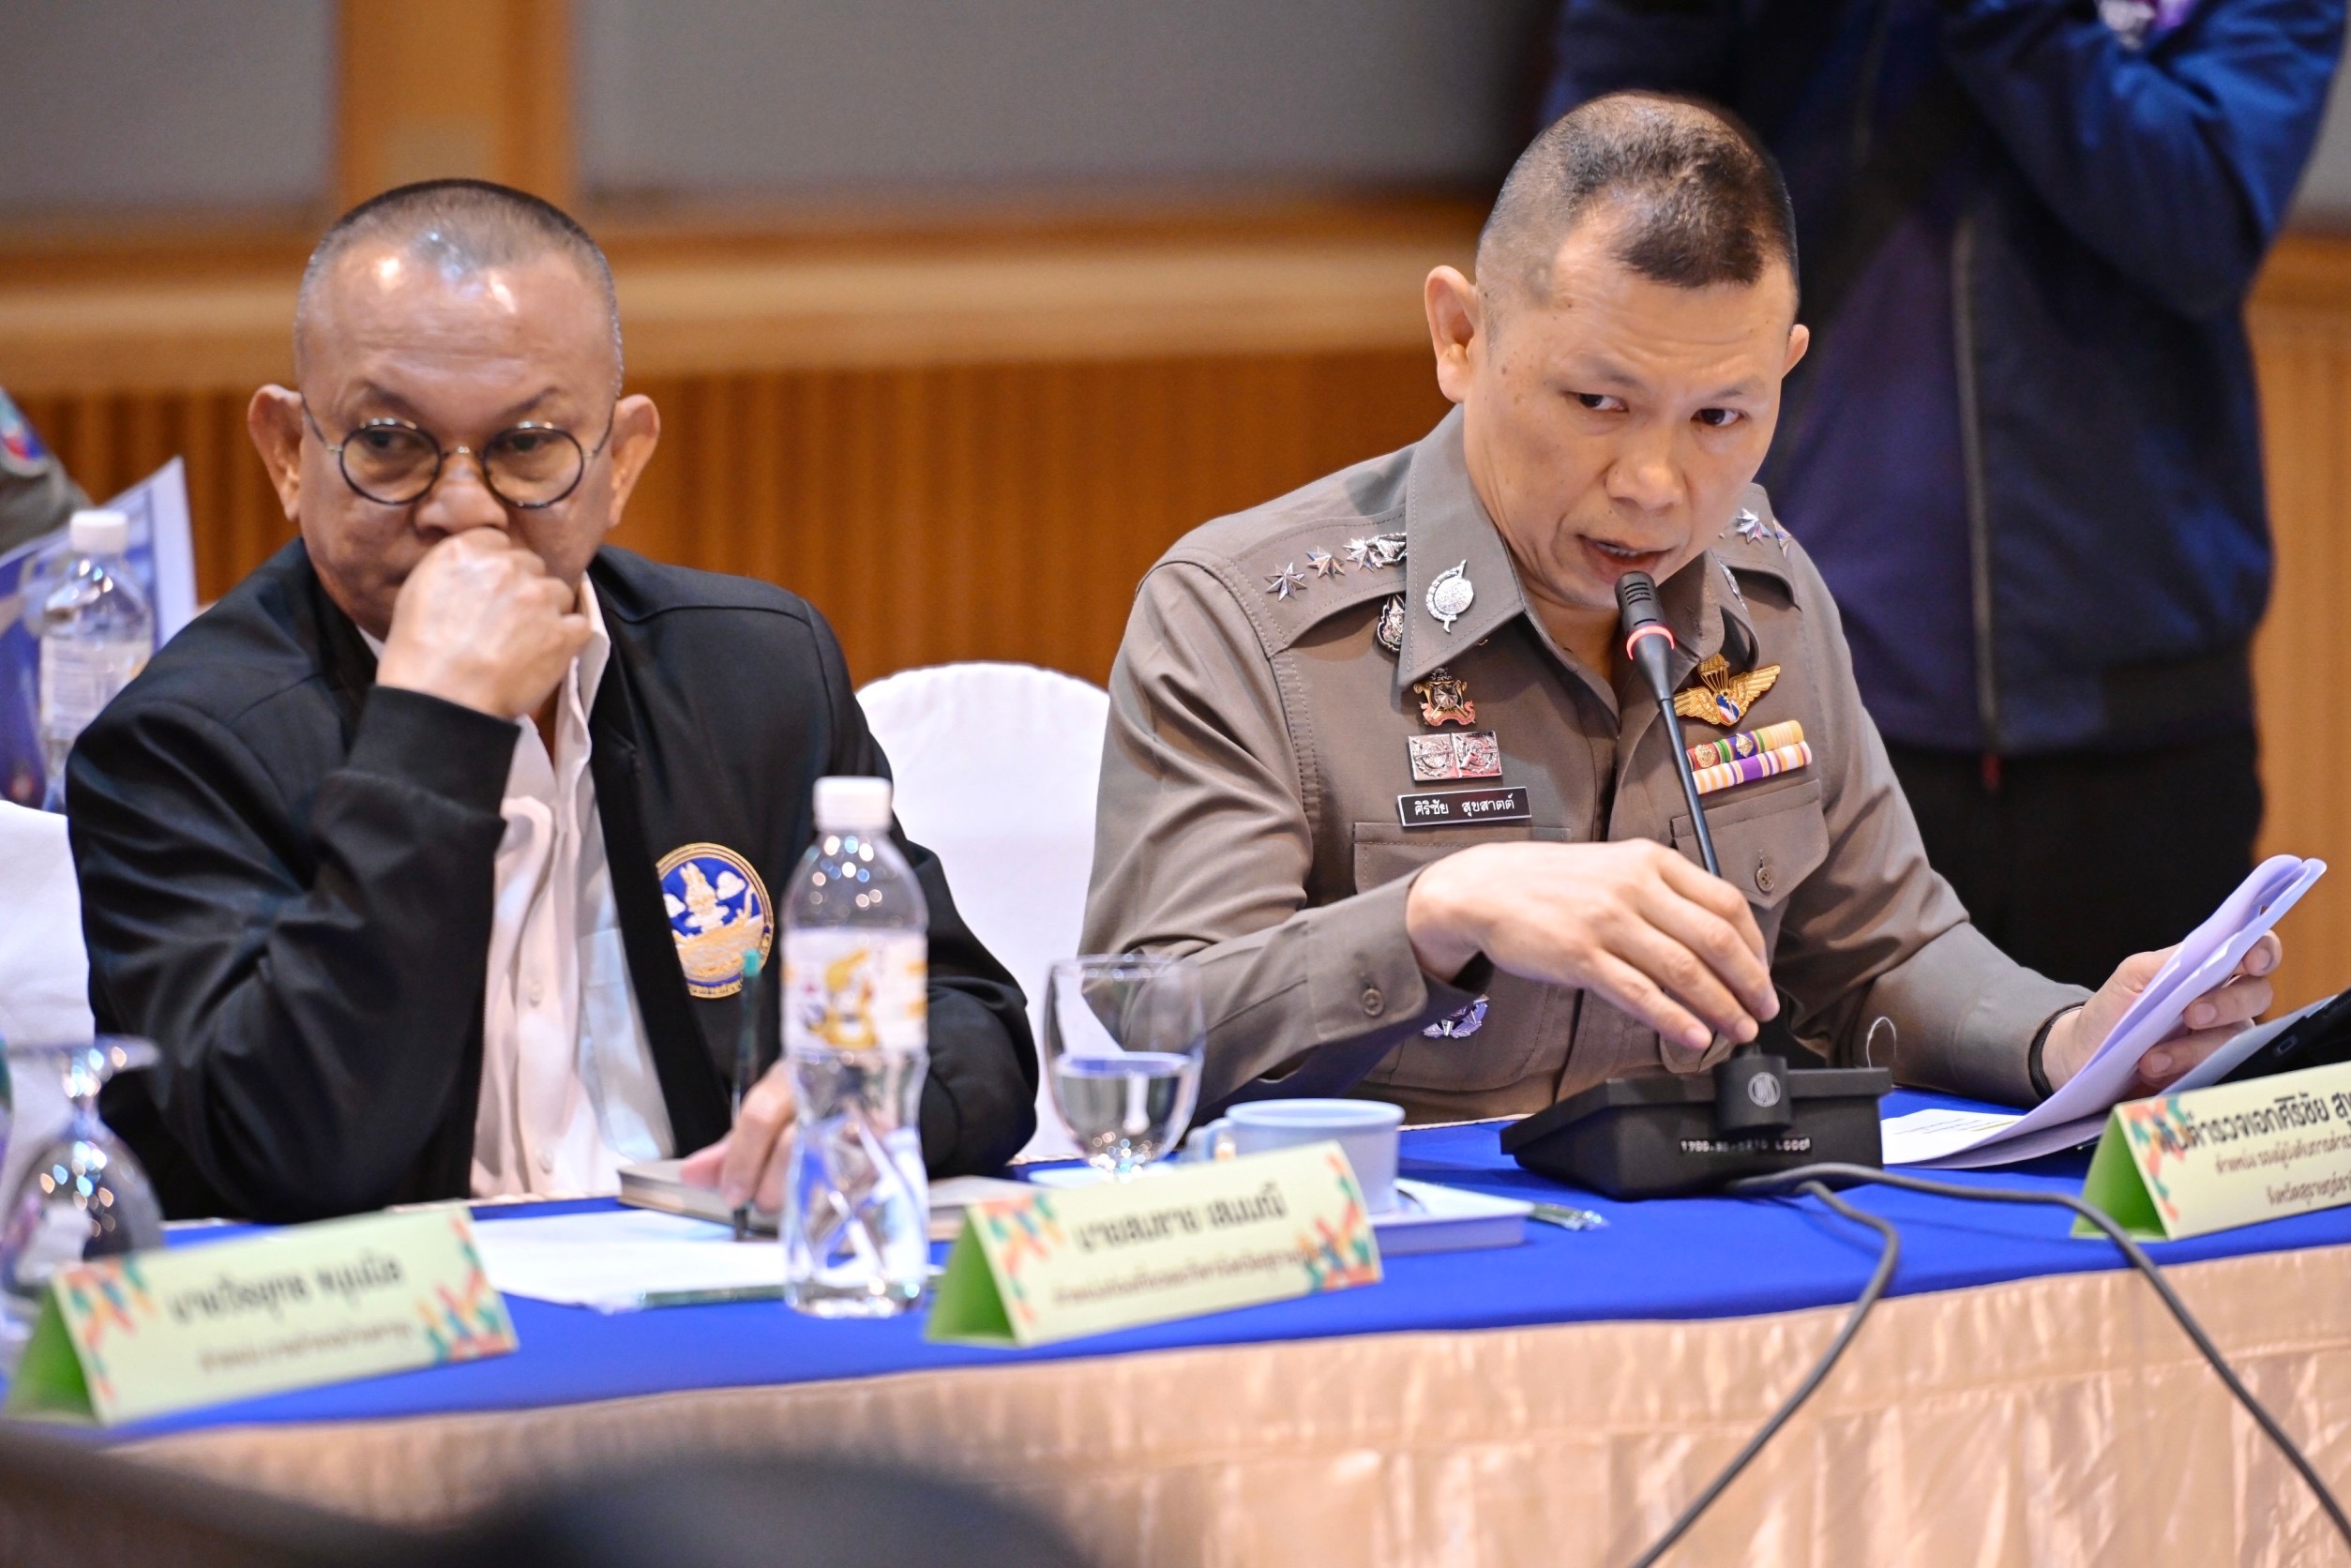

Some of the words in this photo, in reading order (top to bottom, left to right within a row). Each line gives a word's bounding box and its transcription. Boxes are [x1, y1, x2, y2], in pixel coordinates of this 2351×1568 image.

[1414, 799, 1450, 816] ศิริชัย
[1461, 793, 1515, 817] สุขสาตต์
